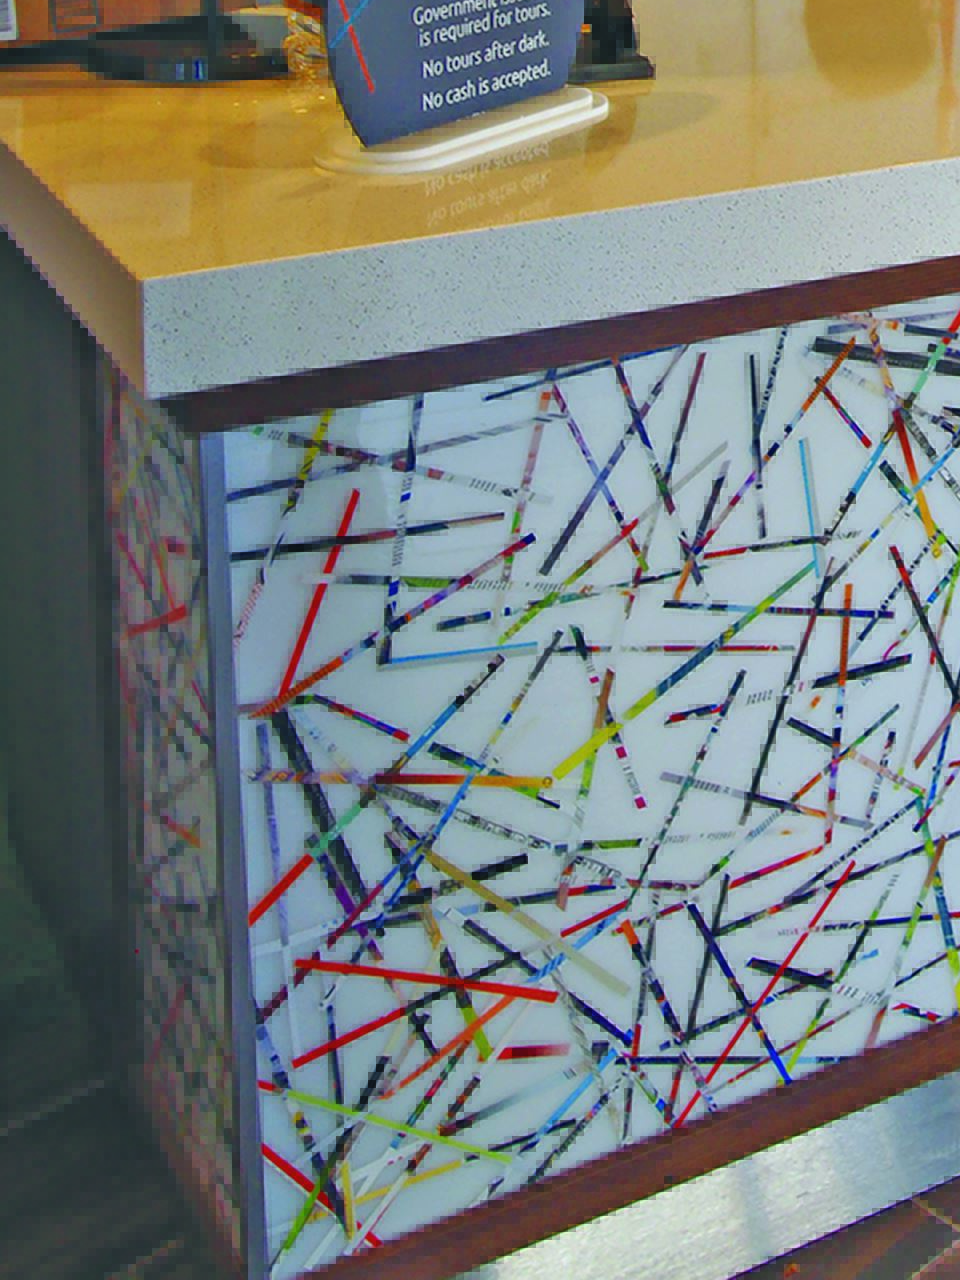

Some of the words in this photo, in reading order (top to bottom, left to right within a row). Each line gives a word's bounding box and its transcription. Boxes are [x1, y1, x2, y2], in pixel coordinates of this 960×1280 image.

[419, 28, 431, 47] is
[434, 12, 491, 43] required
[493, 9, 513, 28] for
[515, 3, 551, 24] tours.
[422, 59, 443, 79] No
[446, 49, 482, 72] tours
[484, 40, 516, 62] after
[518, 29, 550, 53] dark.
[422, 91, 443, 112] No
[446, 79, 476, 104] cash
[478, 76, 490, 95] is
[491, 58, 552, 87] accepted.
